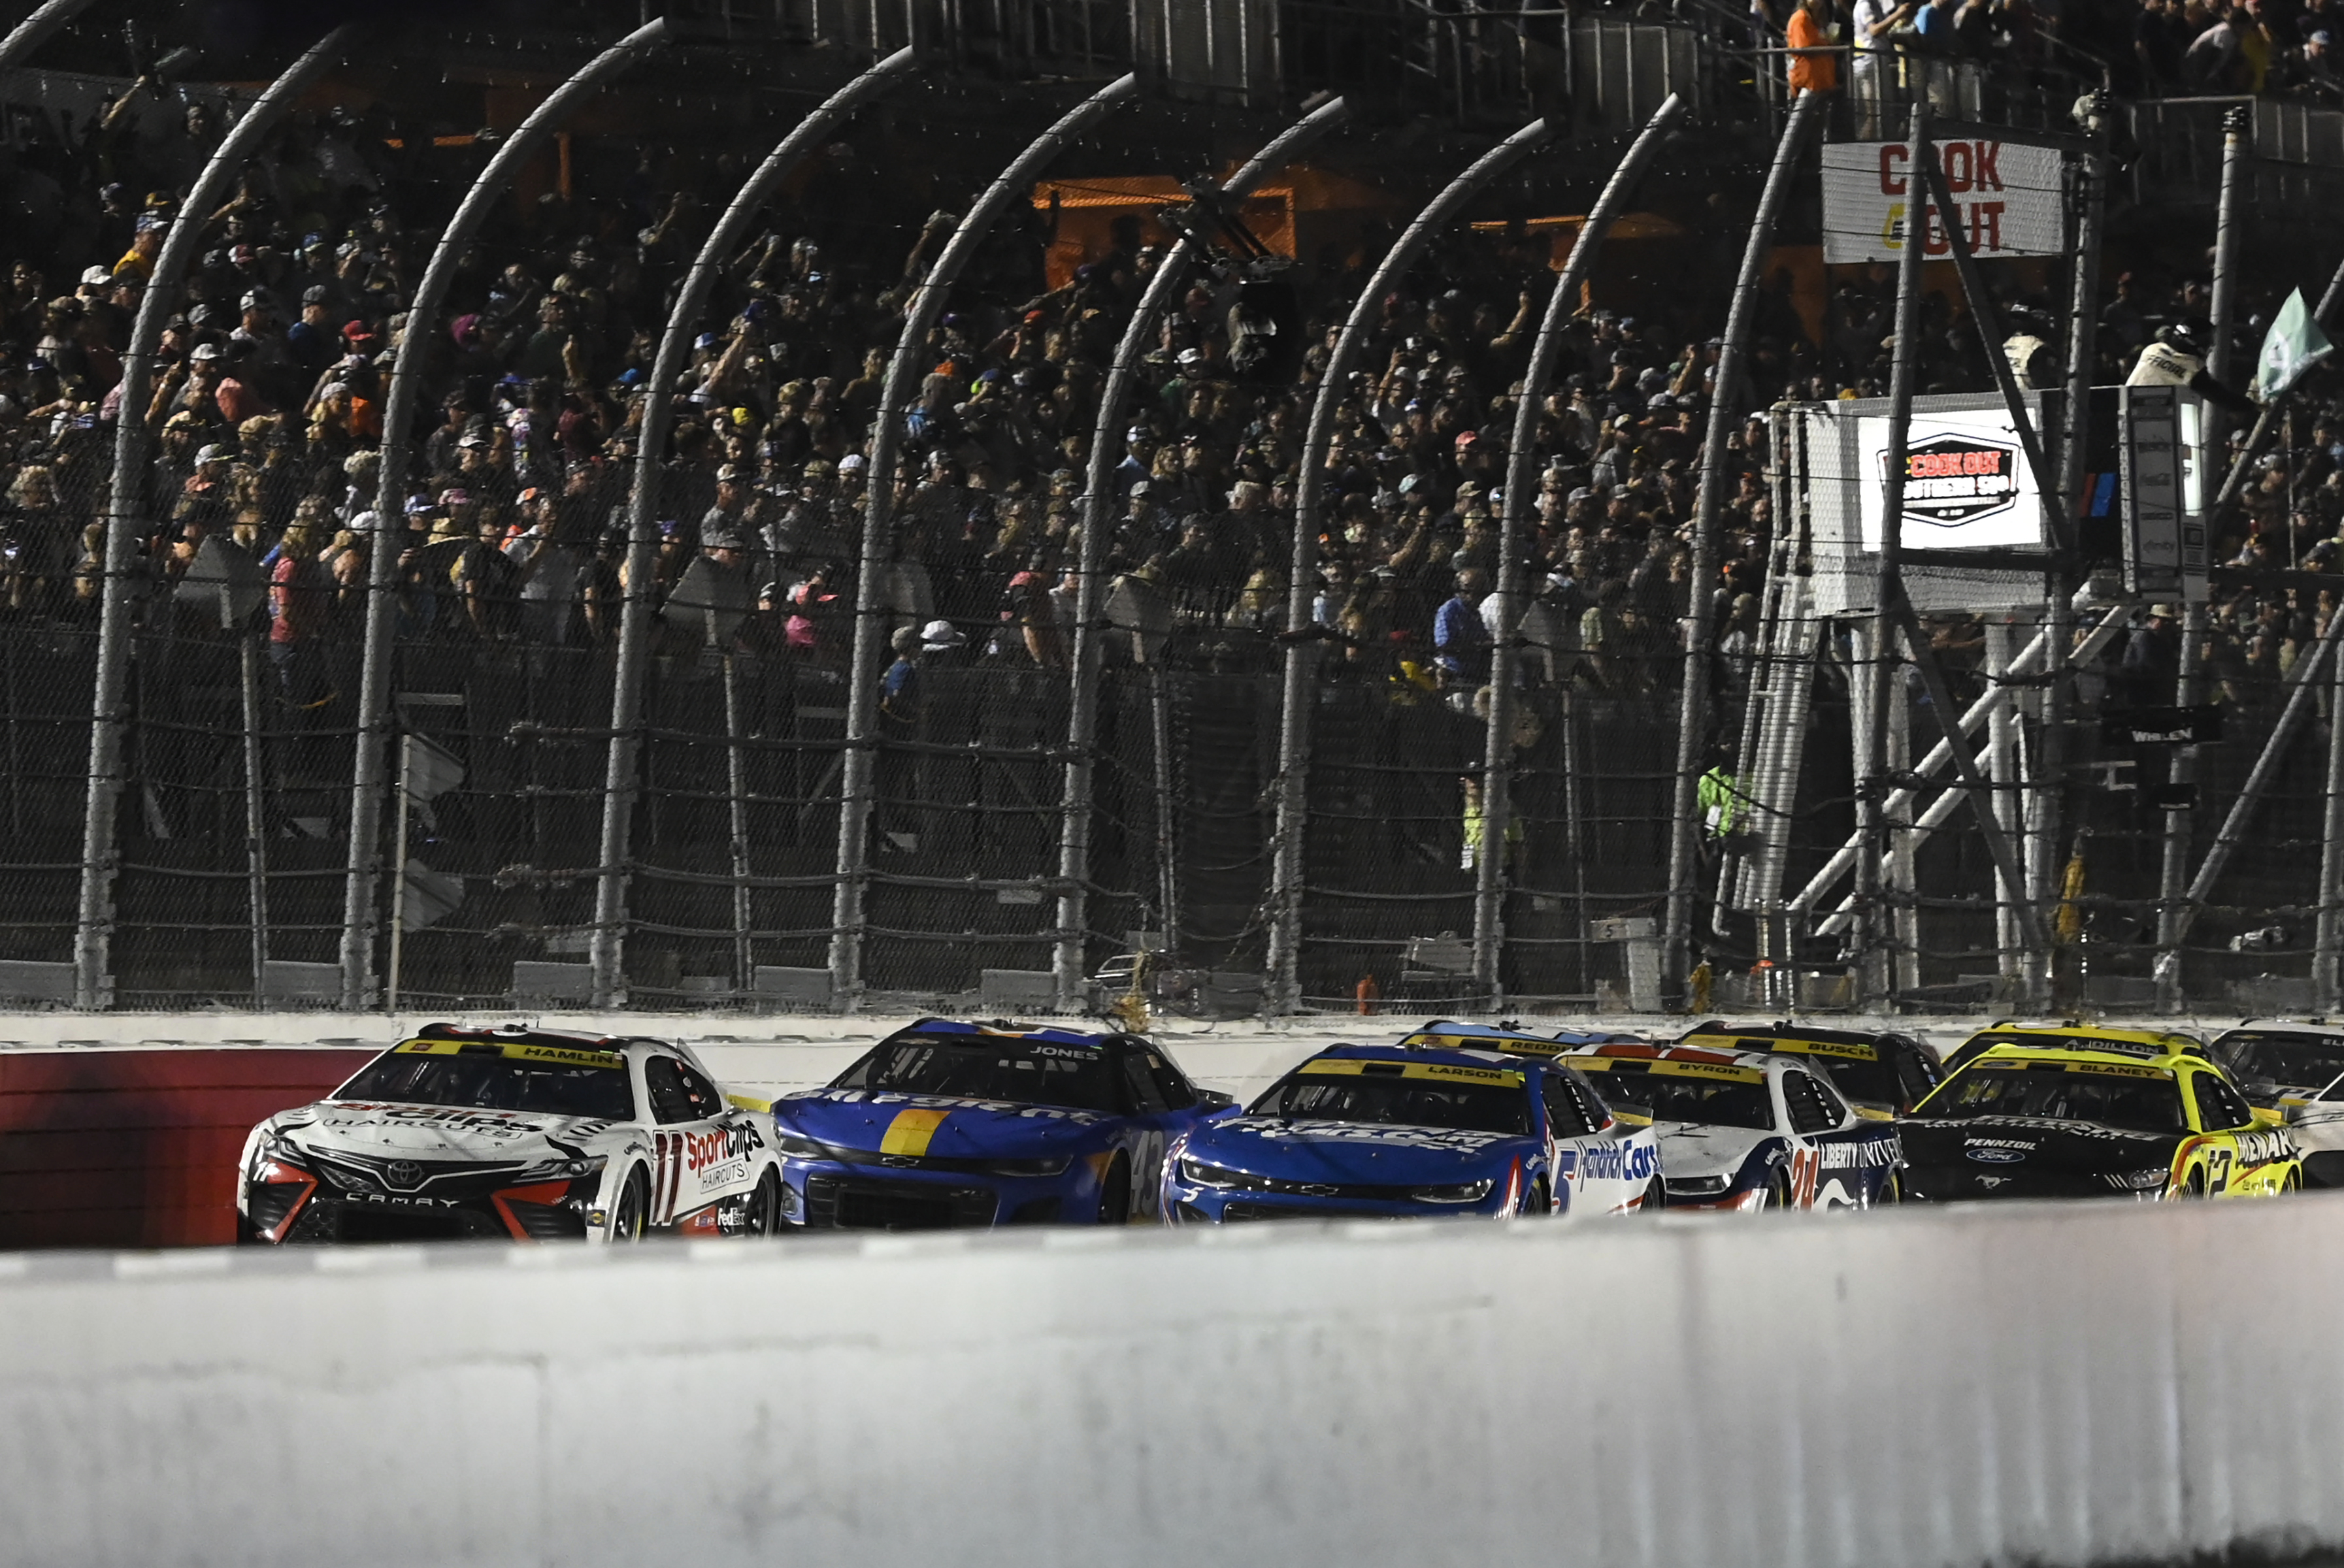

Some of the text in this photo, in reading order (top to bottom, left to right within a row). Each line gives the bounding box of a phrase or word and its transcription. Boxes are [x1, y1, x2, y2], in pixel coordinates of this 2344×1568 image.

[1879, 141, 2004, 195] COK
[524, 1047, 614, 1064] HAMLIN
[1029, 1046, 1098, 1060] JONES
[1808, 1043, 1873, 1057] BUSCH
[1428, 1066, 1502, 1080] LARSON
[1678, 1063, 1740, 1075] BYRON
[2079, 1064, 2156, 1077] BLANEY
[1964, 1138, 2036, 1151] PENNZOIL
[1821, 1142, 1858, 1169] LIBERTY
[1981, 1148, 2014, 1161] Ford
[650, 1130, 684, 1226] 11
[702, 1163, 745, 1189] HAIRCUTS
[1131, 1130, 1164, 1215] 43
[1792, 1148, 1819, 1212] 24
[1181, 1186, 1205, 1202] 5
[718, 1207, 745, 1226] FedEx
